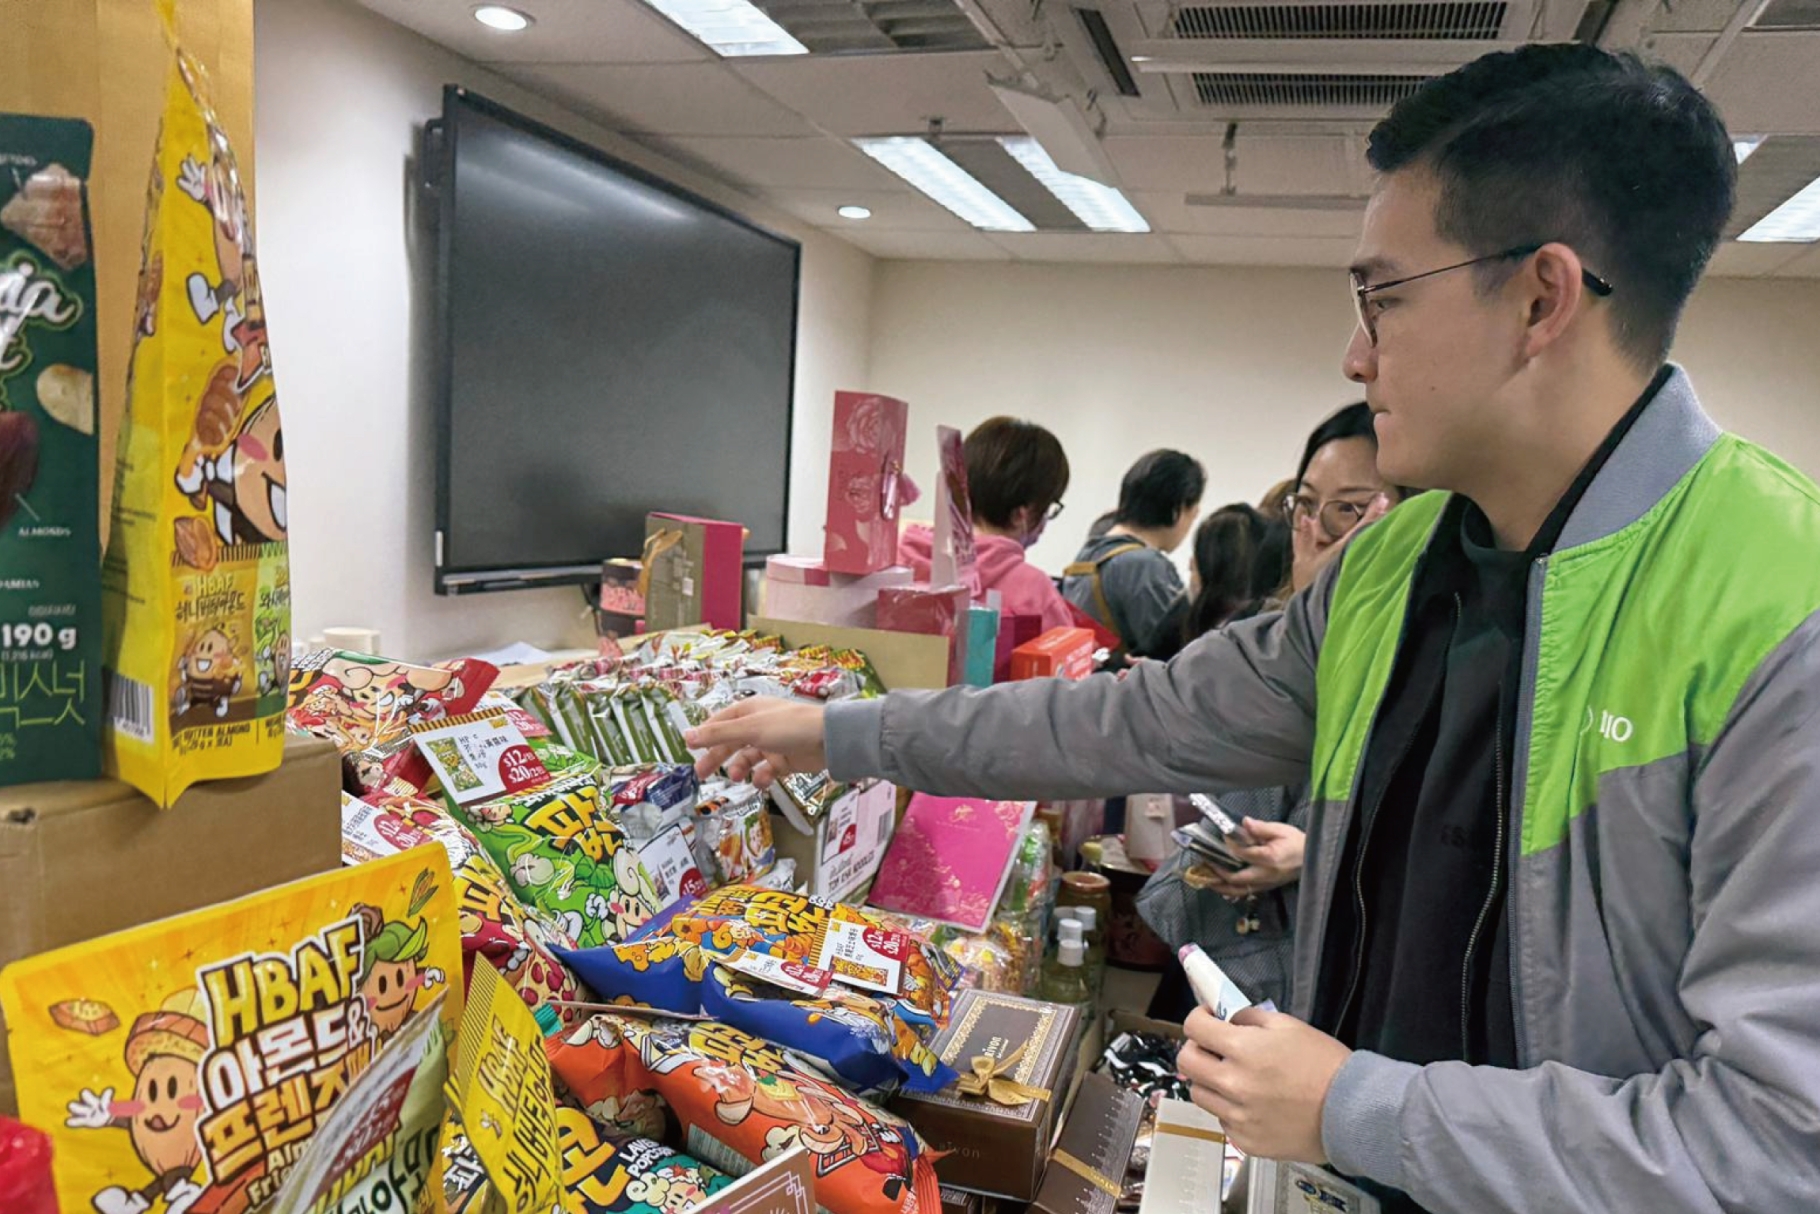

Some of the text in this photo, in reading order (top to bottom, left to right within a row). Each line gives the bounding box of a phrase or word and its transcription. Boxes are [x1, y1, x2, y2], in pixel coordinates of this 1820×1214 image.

[2, 621, 77, 651] 190 g
[203, 920, 360, 1048] HBAF
